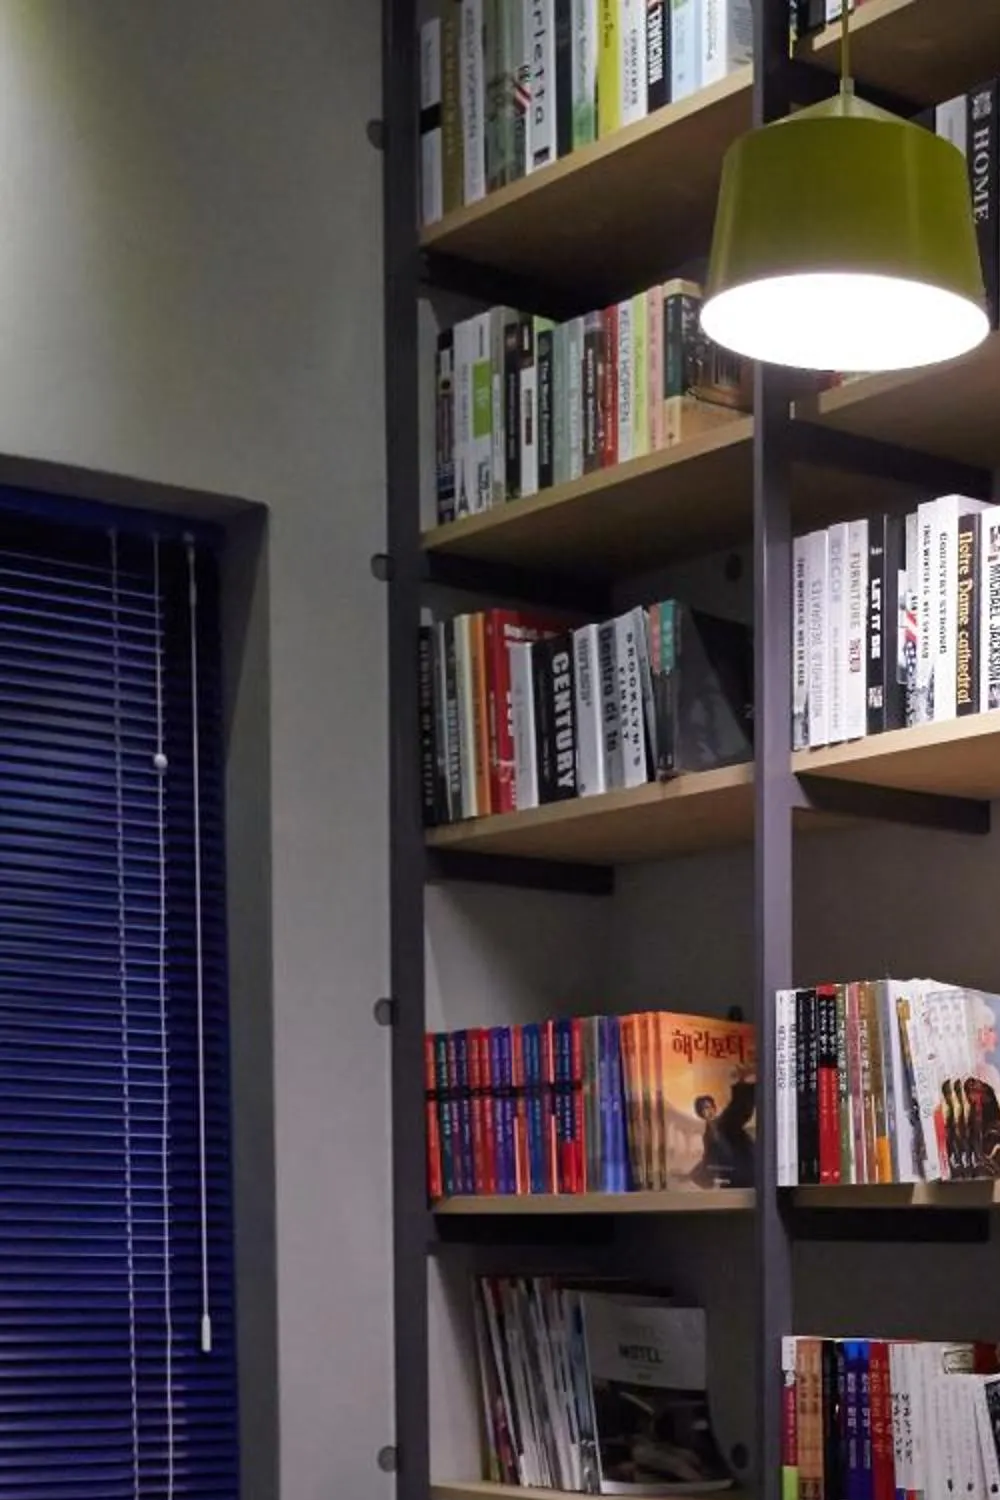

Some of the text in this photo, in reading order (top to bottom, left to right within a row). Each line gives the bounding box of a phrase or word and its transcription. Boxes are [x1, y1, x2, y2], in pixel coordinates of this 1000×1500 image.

[973, 127, 990, 223] HOME
[849, 552, 861, 630] FURNITURE
[871, 577, 882, 611] LET
[957, 532, 973, 705] Notre Dame cathedral
[598, 628, 617, 696] Dentro
[626, 631, 641, 767] BROOKLYN'S
[552, 651, 574, 788] CENTURY
